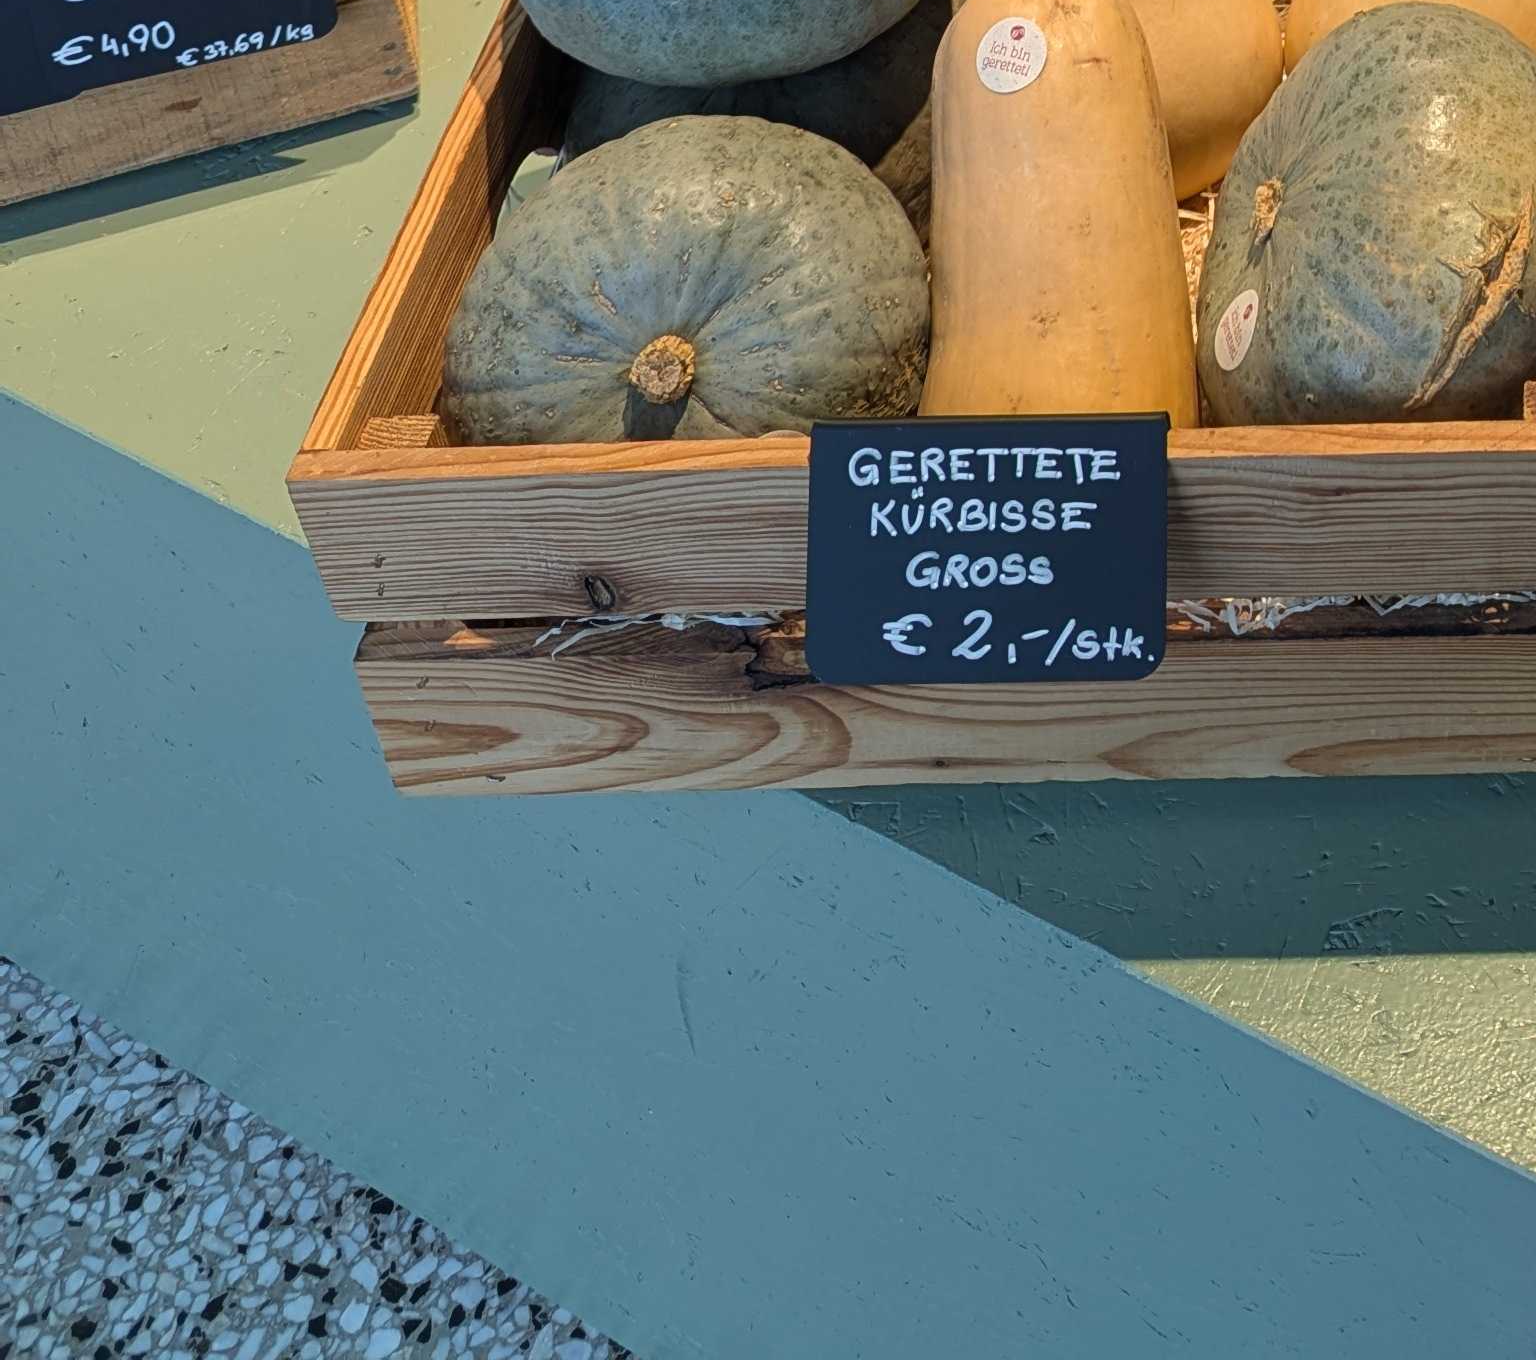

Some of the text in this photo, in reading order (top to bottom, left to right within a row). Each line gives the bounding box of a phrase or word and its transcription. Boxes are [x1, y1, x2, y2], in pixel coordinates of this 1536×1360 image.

[848, 447, 1121, 486] GERETTETE
[870, 486, 1097, 536] KÜRBISSE
[905, 550, 1054, 590] GROSS
